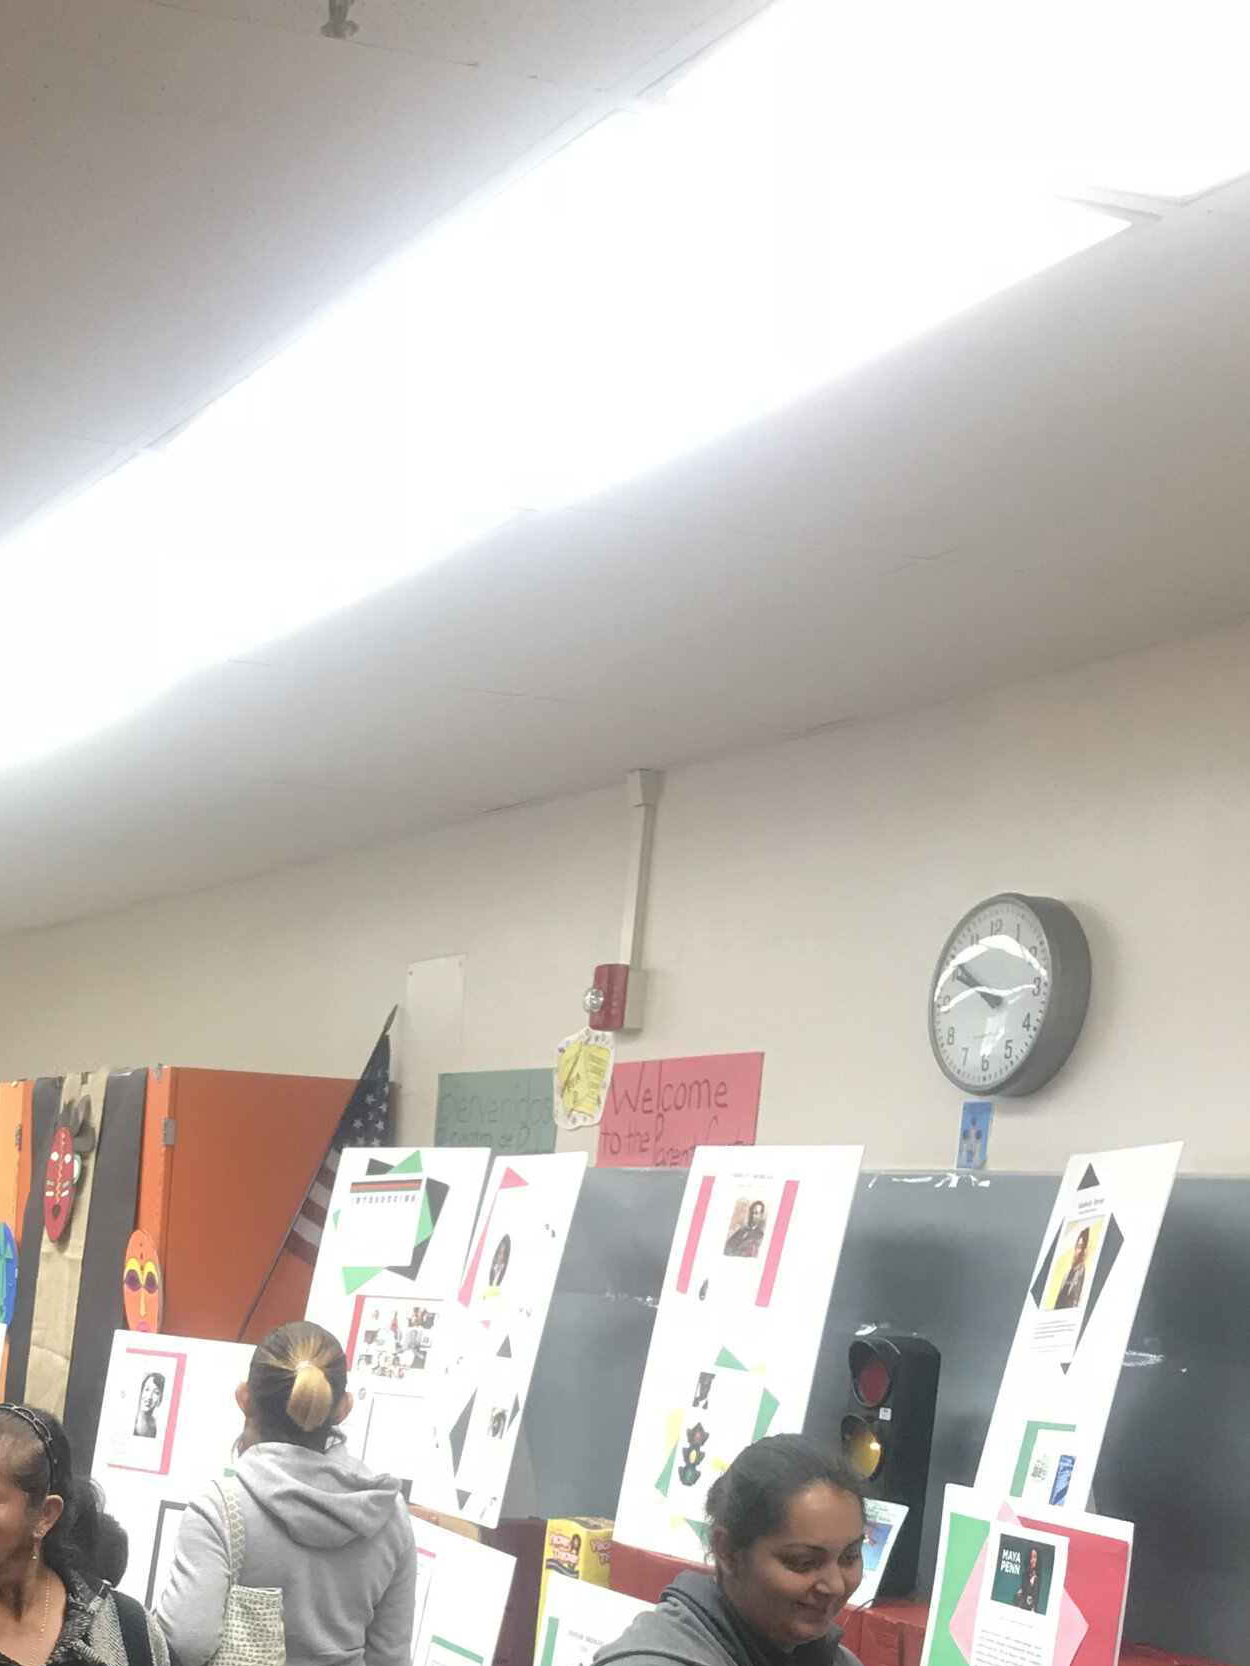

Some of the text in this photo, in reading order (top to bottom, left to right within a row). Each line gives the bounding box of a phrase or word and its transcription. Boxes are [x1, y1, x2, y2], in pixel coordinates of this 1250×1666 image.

[990, 918, 1003, 937] 12
[1031, 976, 1042, 997] 3
[1021, 1013, 1031, 1031] 4
[946, 1026, 956, 1046] 8
[961, 1047, 969, 1067] 7
[1004, 1039, 1013, 1060] 5
[981, 1053, 990, 1072] 6
[611, 1059, 729, 1115] Welcome
[601, 1126, 621, 1155] to
[626, 1122, 651, 1155] the
[1002, 1548, 1021, 1564] MAYA
[1000, 1560, 1021, 1576] PENN
